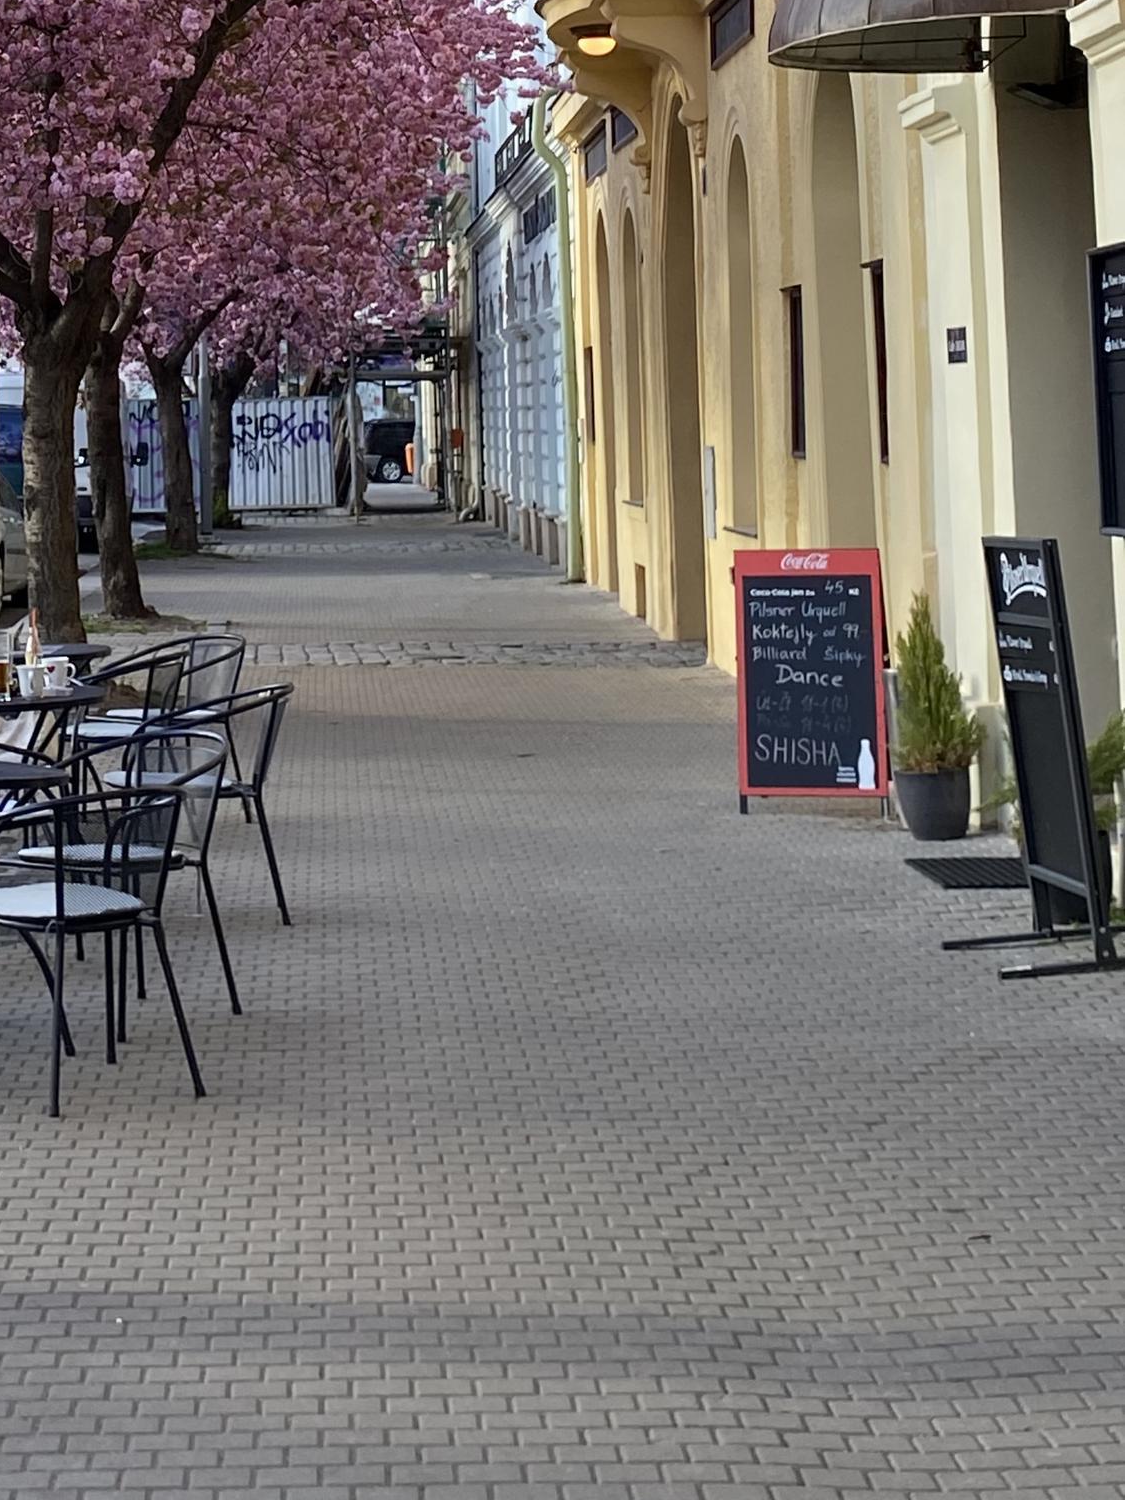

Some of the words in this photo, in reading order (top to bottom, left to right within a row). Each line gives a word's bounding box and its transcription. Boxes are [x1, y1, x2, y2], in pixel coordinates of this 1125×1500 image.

[825, 581, 844, 595] 45
[749, 602, 794, 618] Pilsner
[802, 601, 846, 624] Urquell
[752, 623, 815, 646] Koktejly
[752, 647, 807, 661] Billiard
[776, 663, 843, 687] Dance
[754, 734, 841, 766] SHISHA
